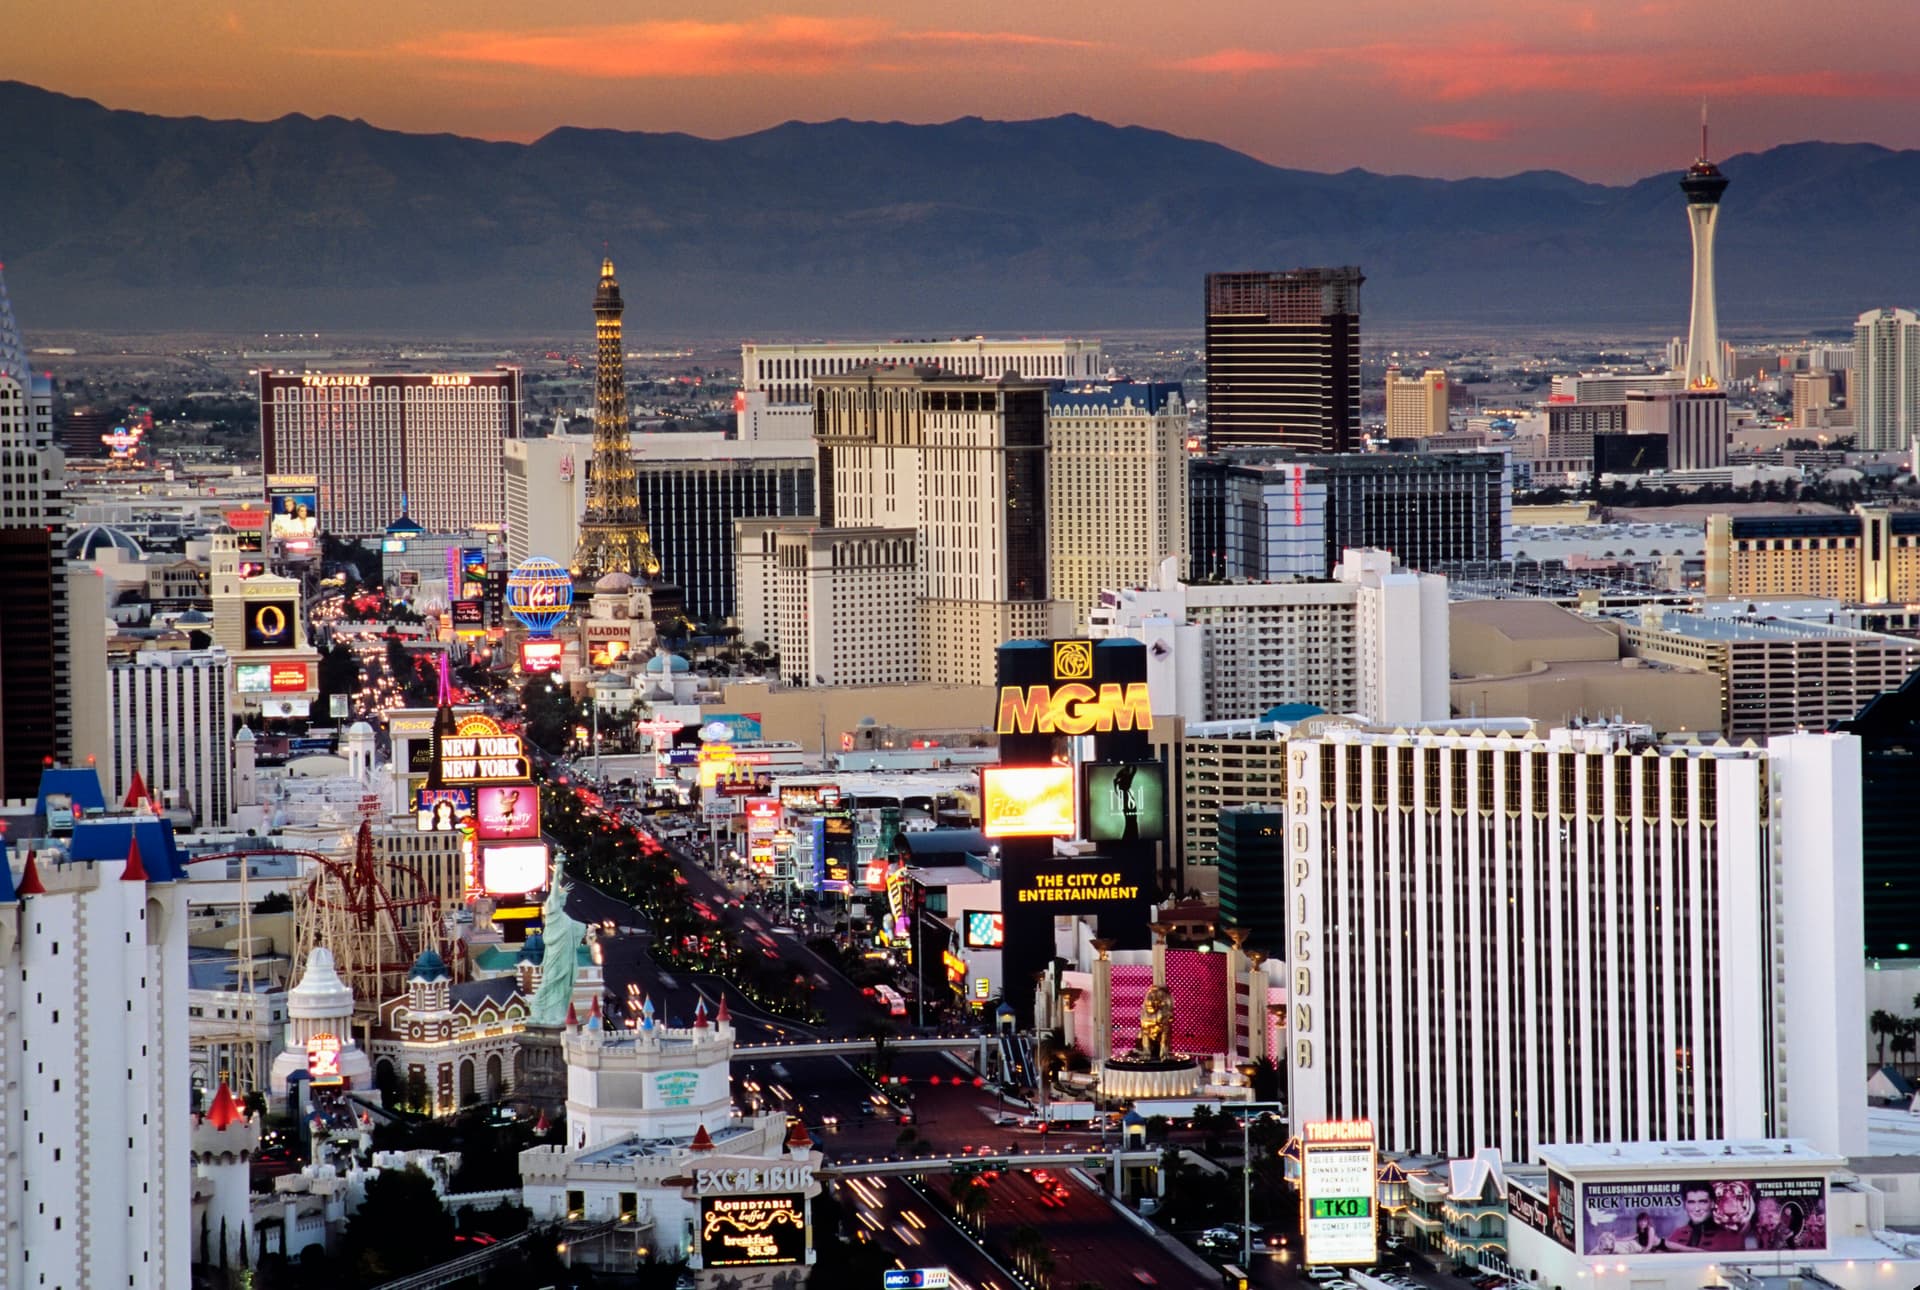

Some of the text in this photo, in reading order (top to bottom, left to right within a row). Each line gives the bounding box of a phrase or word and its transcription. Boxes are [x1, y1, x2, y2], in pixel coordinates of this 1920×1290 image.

[302, 376, 470, 387] TREASURE ISLAND
[529, 581, 557, 611] Paris
[255, 605, 286, 637] O
[588, 627, 631, 636] ALADDIN
[997, 683, 1153, 735] MGM
[442, 738, 476, 757] NEW
[477, 737, 520, 756] YORK
[442, 759, 520, 778] NEW YORK
[422, 790, 468, 805] RITA
[1036, 873, 1120, 887] THE CITY OF
[1018, 887, 1138, 902] ENTERTAINMENT
[1292, 750, 1312, 1068] TROPICANA
[1307, 1122, 1371, 1140] TROPICANA
[697, 1165, 816, 1194] EXCALIBUR
[1796, 1181, 1821, 1189] FANTASY
[1588, 1184, 1681, 1194] THE ILLUSIONARY MAGIC OF
[714, 1200, 793, 1211] ROUNDTABLE
[1324, 1200, 1358, 1216] TKO
[1588, 1194, 1682, 1209] RICK THOMAS
[739, 1210, 766, 1223] buffet
[1322, 1222, 1350, 1232] COMEDY
[1354, 1220, 1372, 1231] STOP
[724, 1233, 775, 1246] breakfast
[886, 1276, 910, 1285] ARCO
